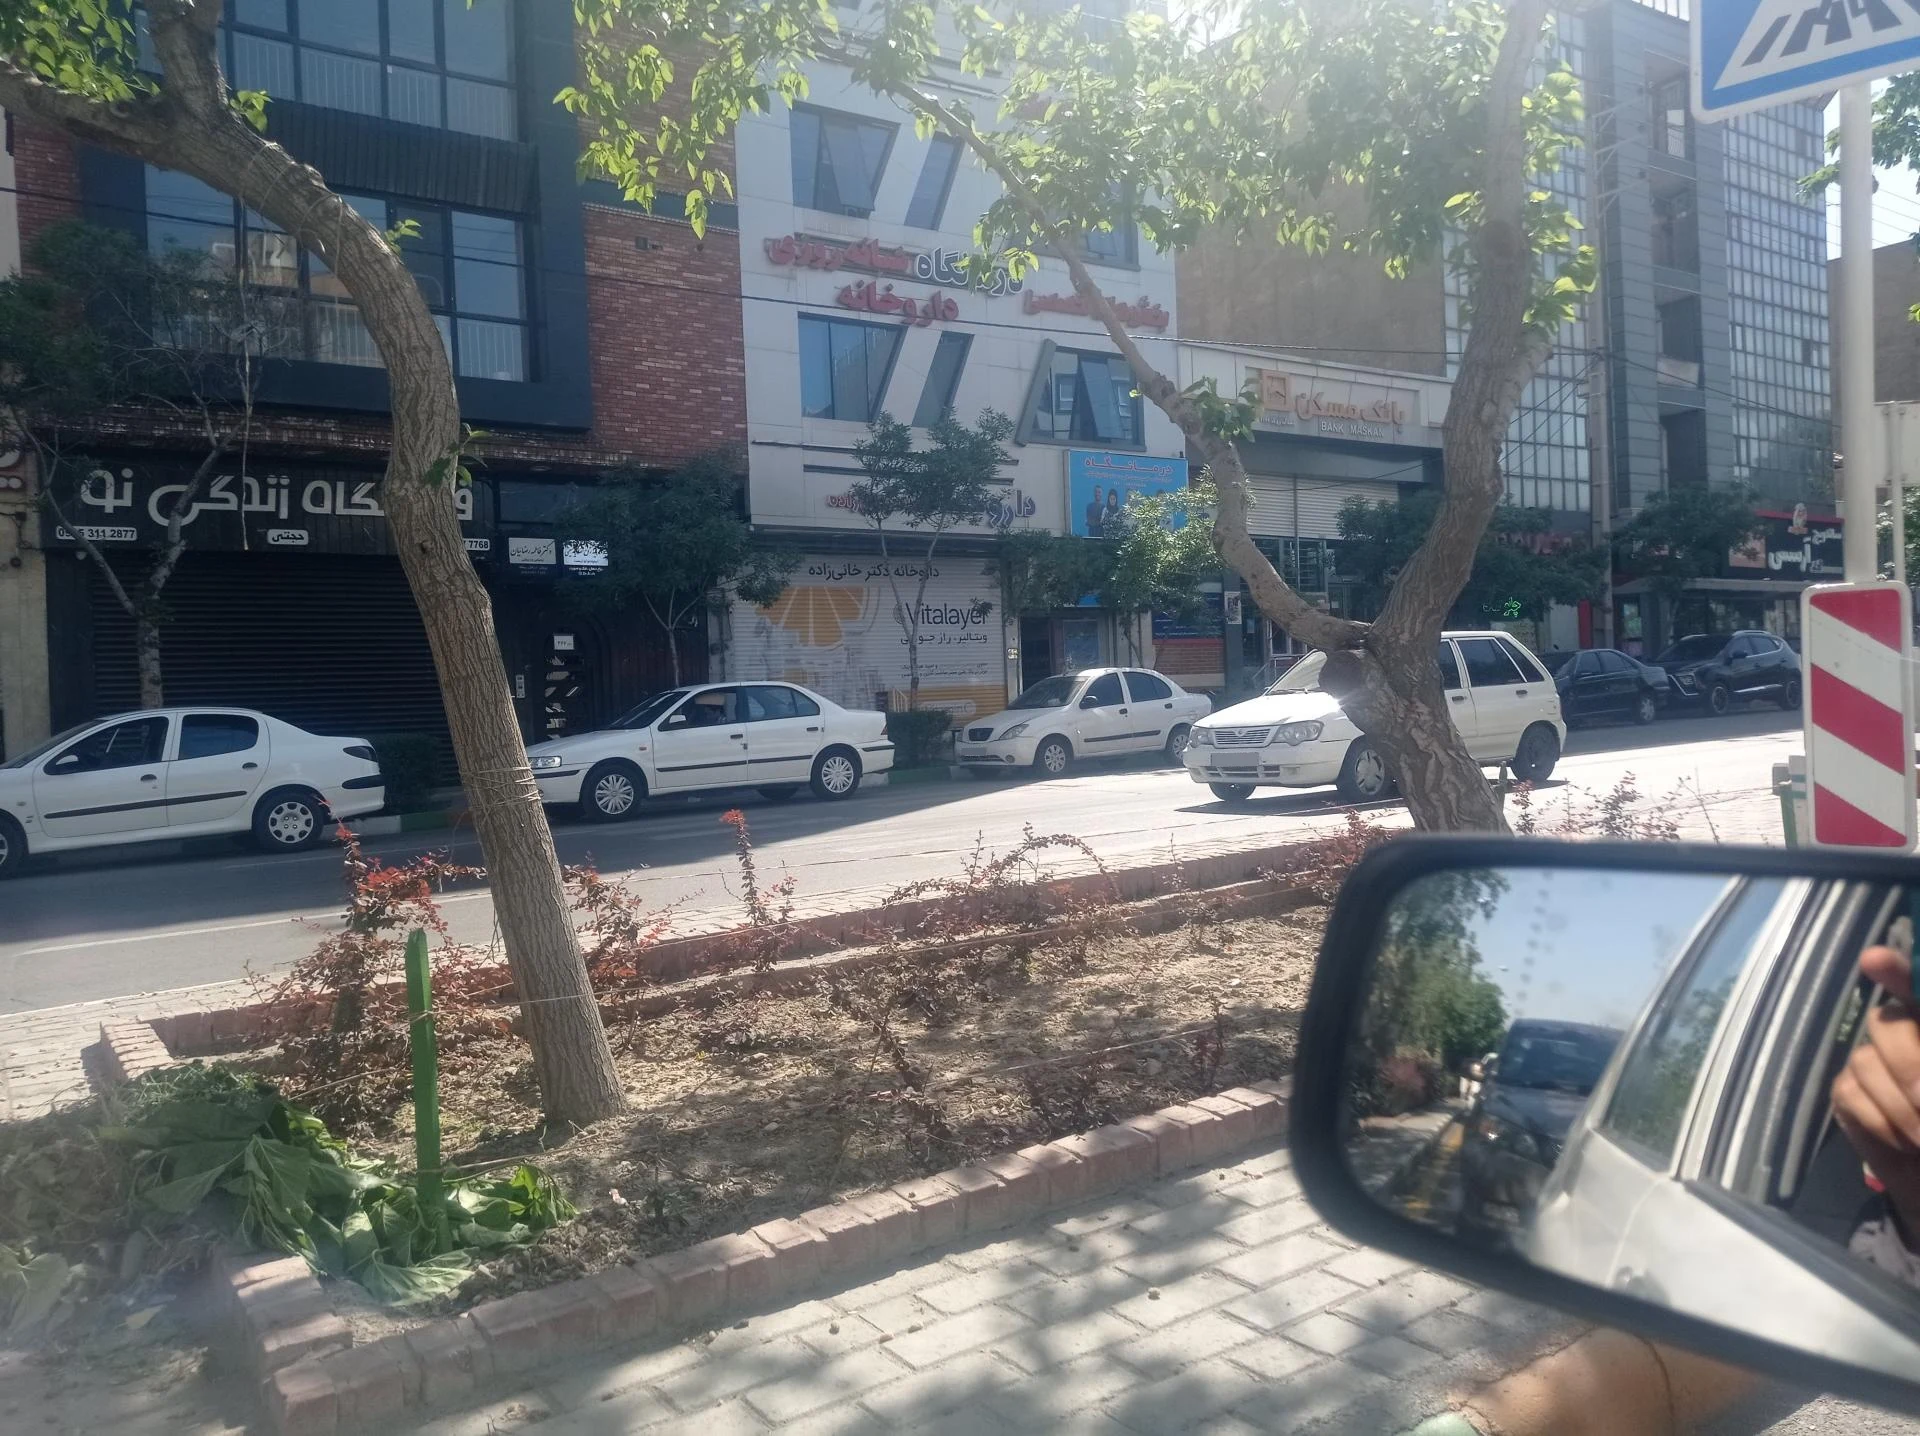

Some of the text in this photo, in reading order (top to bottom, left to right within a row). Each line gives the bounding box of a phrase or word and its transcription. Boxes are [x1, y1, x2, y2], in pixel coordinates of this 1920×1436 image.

[836, 279, 960, 327] داروخانه
[1295, 391, 1405, 433] بانک مسکن
[1320, 420, 1385, 438] BANK MASKAN
[80, 468, 134, 513] نو
[148, 474, 291, 527] زندگی
[88, 529, 106, 538] 311
[110, 529, 135, 539] 2877
[271, 530, 305, 544] حجتی
[468, 540, 489, 549] 7768
[864, 562, 890, 582] دکتر
[893, 562, 940, 581] داروخانه
